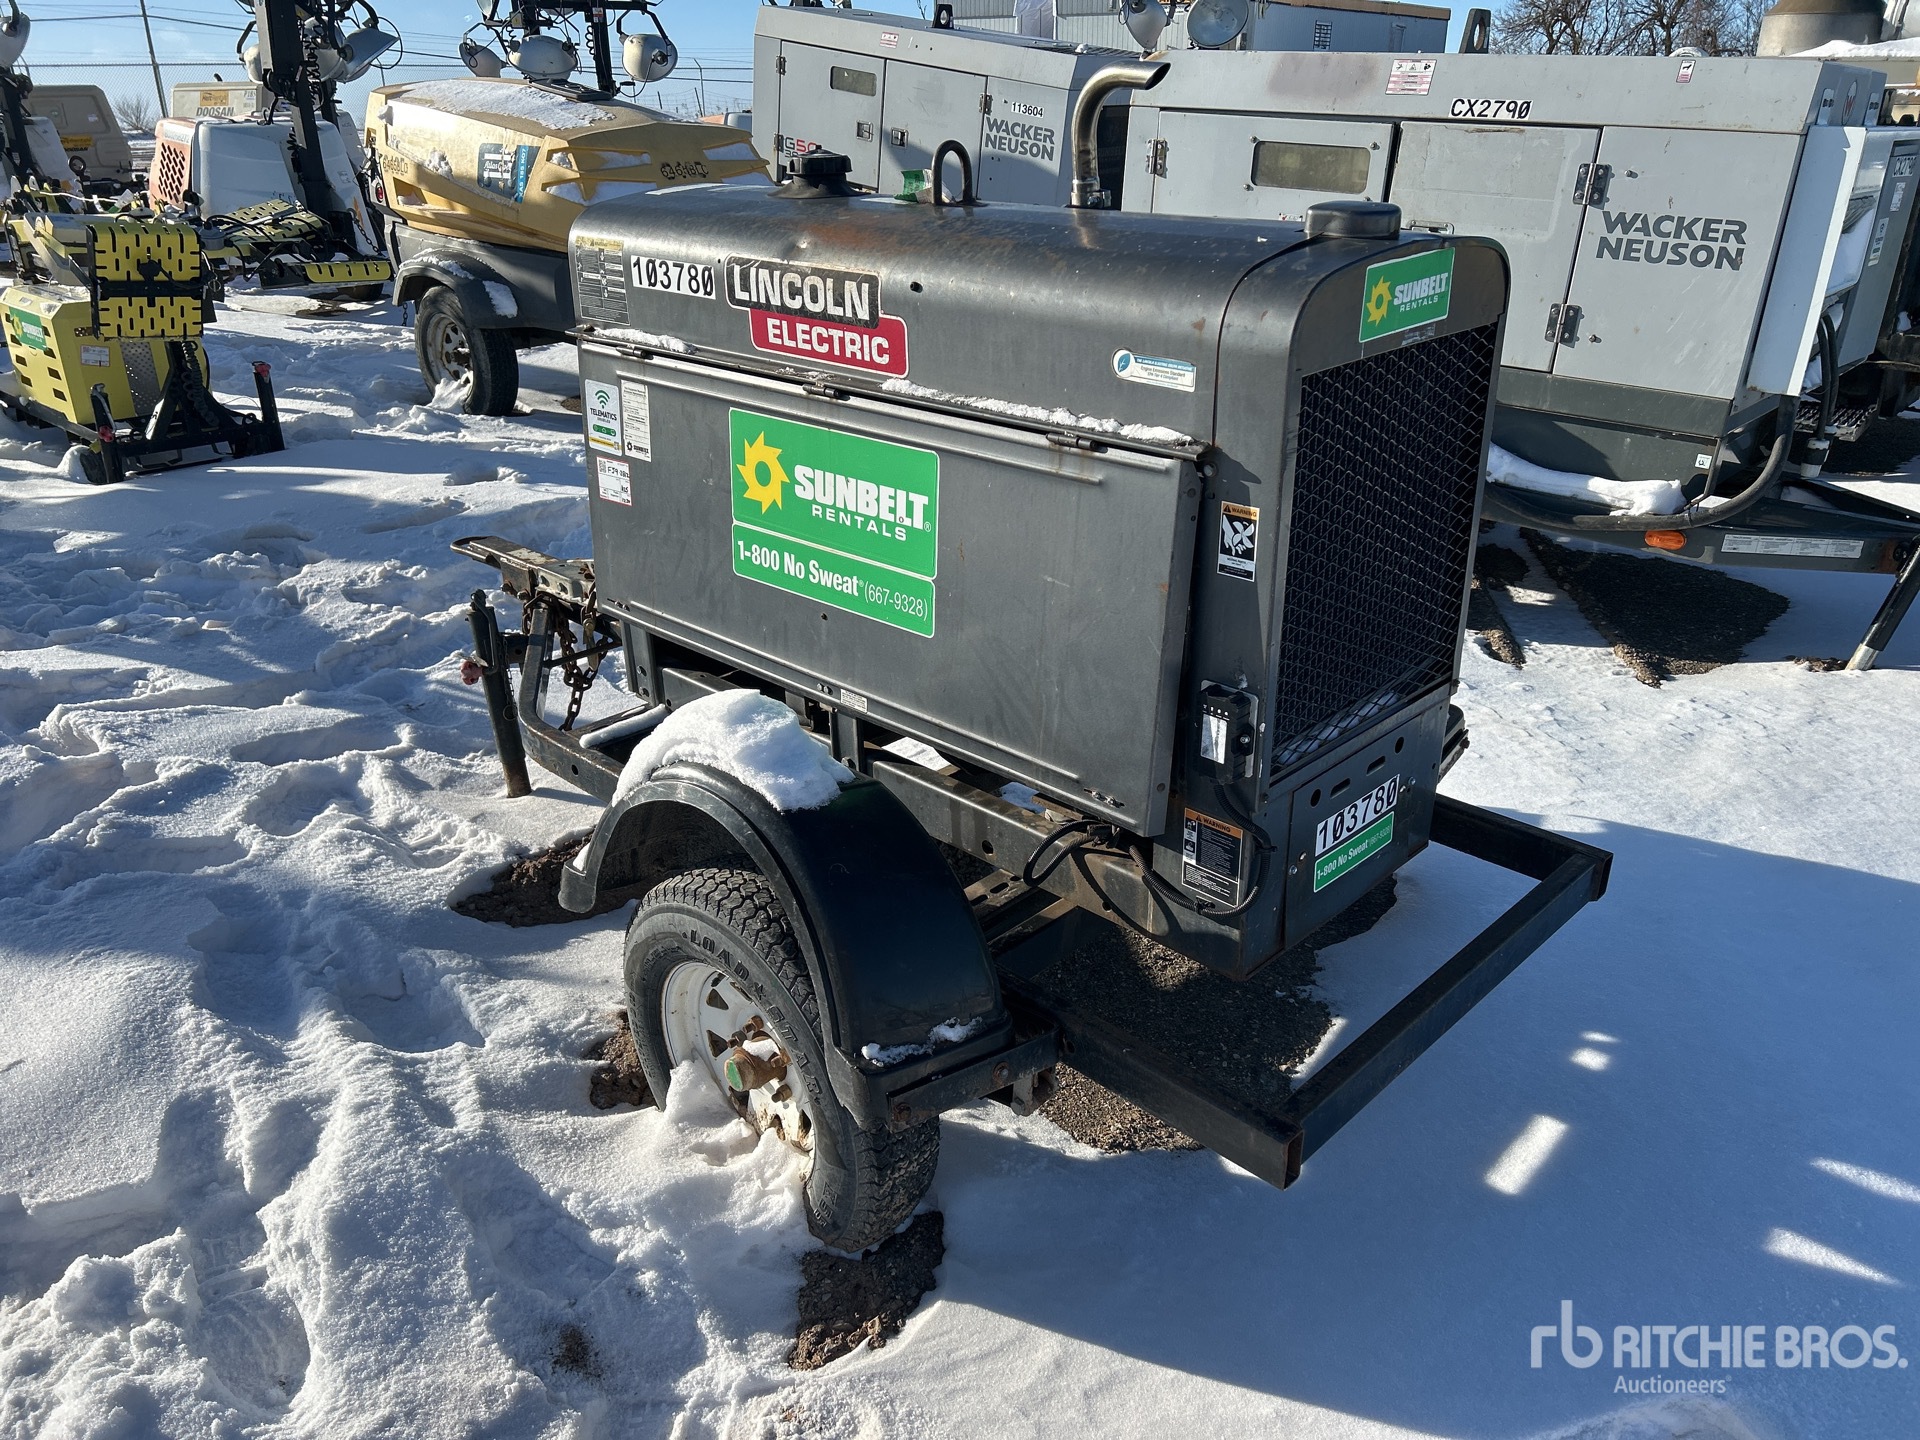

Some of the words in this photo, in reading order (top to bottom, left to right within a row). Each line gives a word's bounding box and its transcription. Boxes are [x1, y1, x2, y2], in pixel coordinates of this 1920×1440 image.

[196, 107, 234, 117] DOOSAN
[1012, 102, 1043, 117] 113604
[1451, 98, 1532, 119] CX2790
[985, 133, 1055, 161] NEUSON
[986, 116, 1055, 145] WACKER
[1602, 210, 1748, 245] WACKER
[1596, 236, 1745, 271] NEUSON
[632, 256, 714, 297] 103780
[733, 264, 870, 321] LINCOLN
[1394, 272, 1449, 306] SUNBELT
[1400, 295, 1439, 313] RENTALS
[766, 317, 890, 365] ELECTRIC
[590, 408, 618, 421] TELEMATICS
[795, 465, 929, 530] SUNBELT
[1232, 507, 1257, 517] WARNING
[812, 504, 907, 541] RENTALS
[738, 540, 780, 571] 1-800
[784, 552, 805, 580] No
[864, 581, 929, 622] (667-9328)
[1203, 818, 1231, 834] WARNING
[1319, 777, 1398, 850] 103780
[1317, 859, 1337, 880] 1-800
[1338, 854, 1348, 868] No
[689, 928, 750, 982] LOAD
[765, 1005, 823, 1095] STAR
